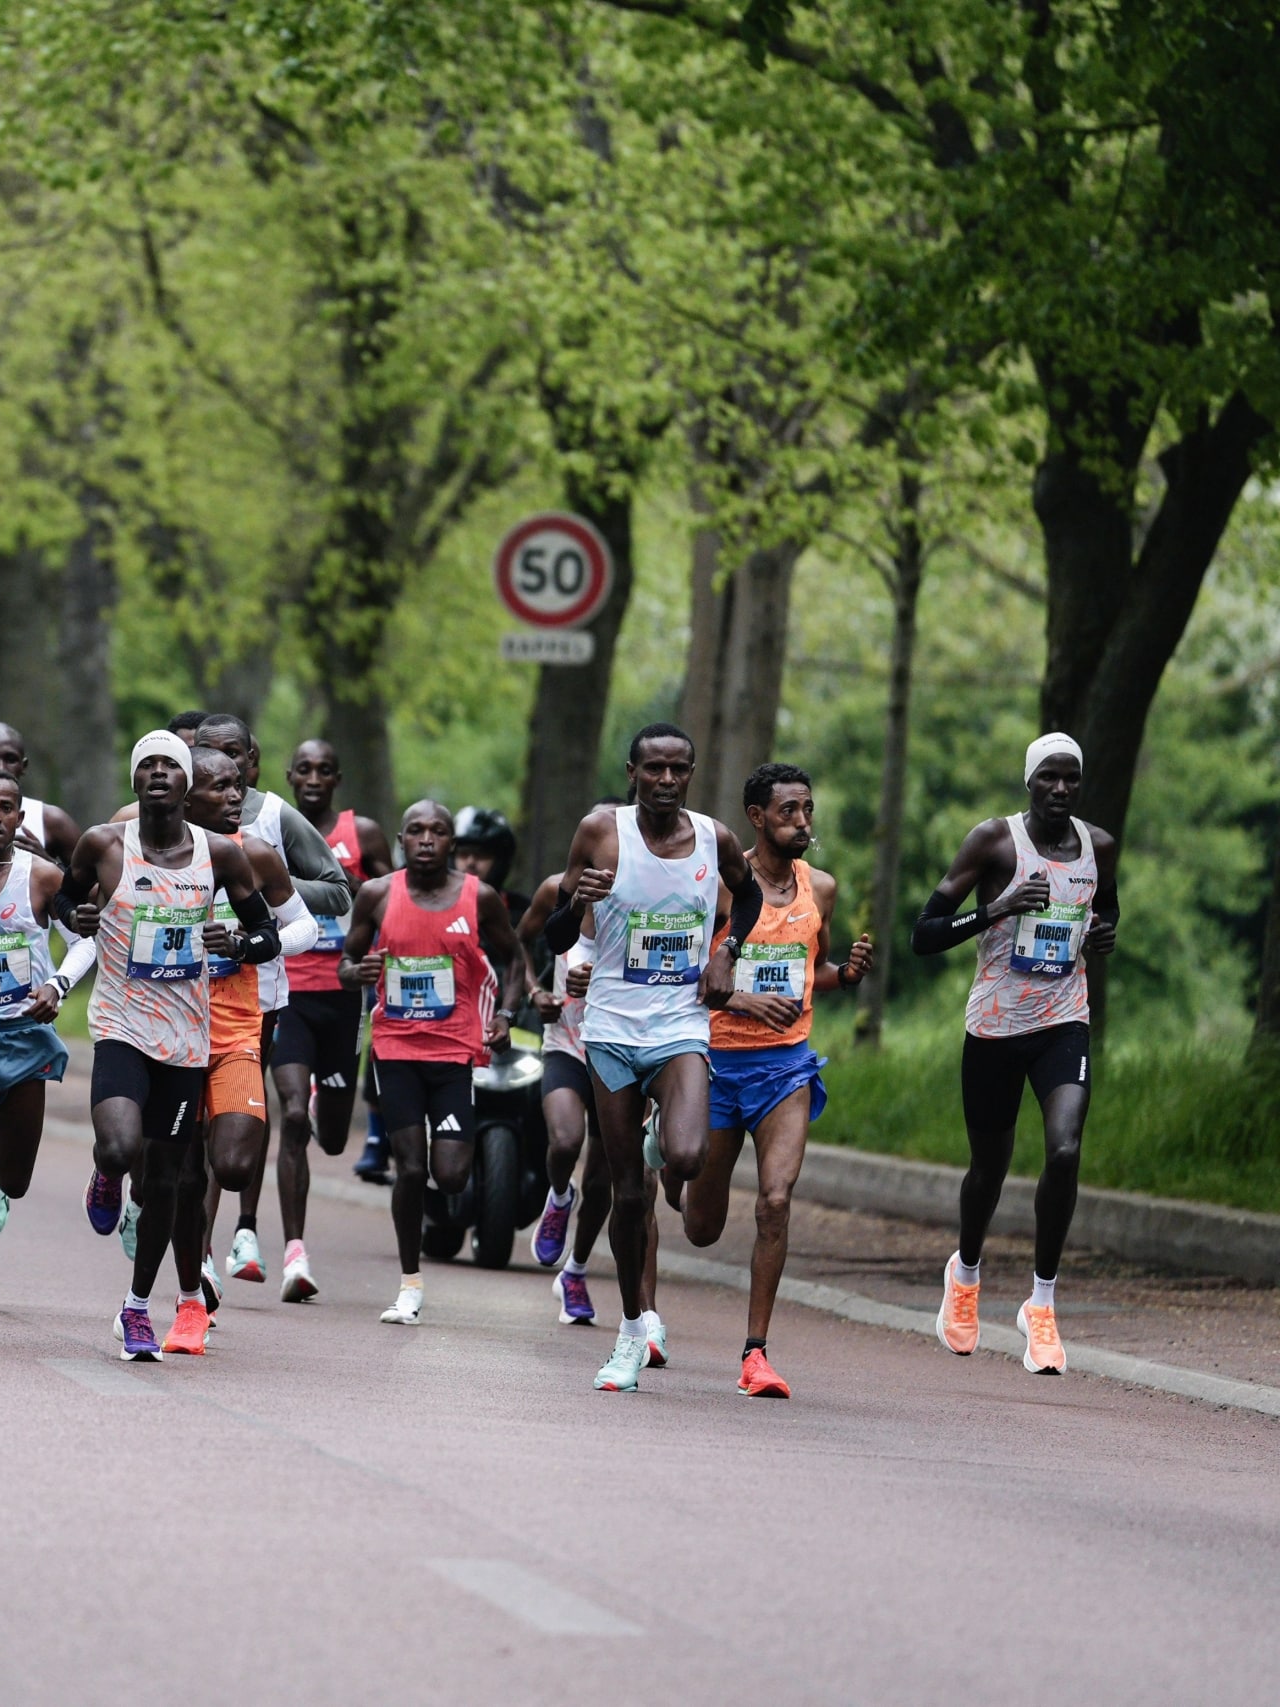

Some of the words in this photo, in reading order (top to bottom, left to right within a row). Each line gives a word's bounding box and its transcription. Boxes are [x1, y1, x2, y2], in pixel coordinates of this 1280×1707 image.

[521, 547, 584, 596] 50
[174, 883, 210, 892] KIPRUN
[158, 906, 203, 919] Schneider
[1044, 903, 1083, 915] chneider
[652, 913, 697, 924] Schneider
[162, 927, 186, 951] 30
[641, 934, 695, 952] KIPSIIRAT
[756, 944, 801, 955] Schneider
[1017, 945, 1026, 956] 18
[629, 957, 639, 968] 31
[756, 966, 789, 983] AYELE
[400, 976, 436, 991] BIWOTT
